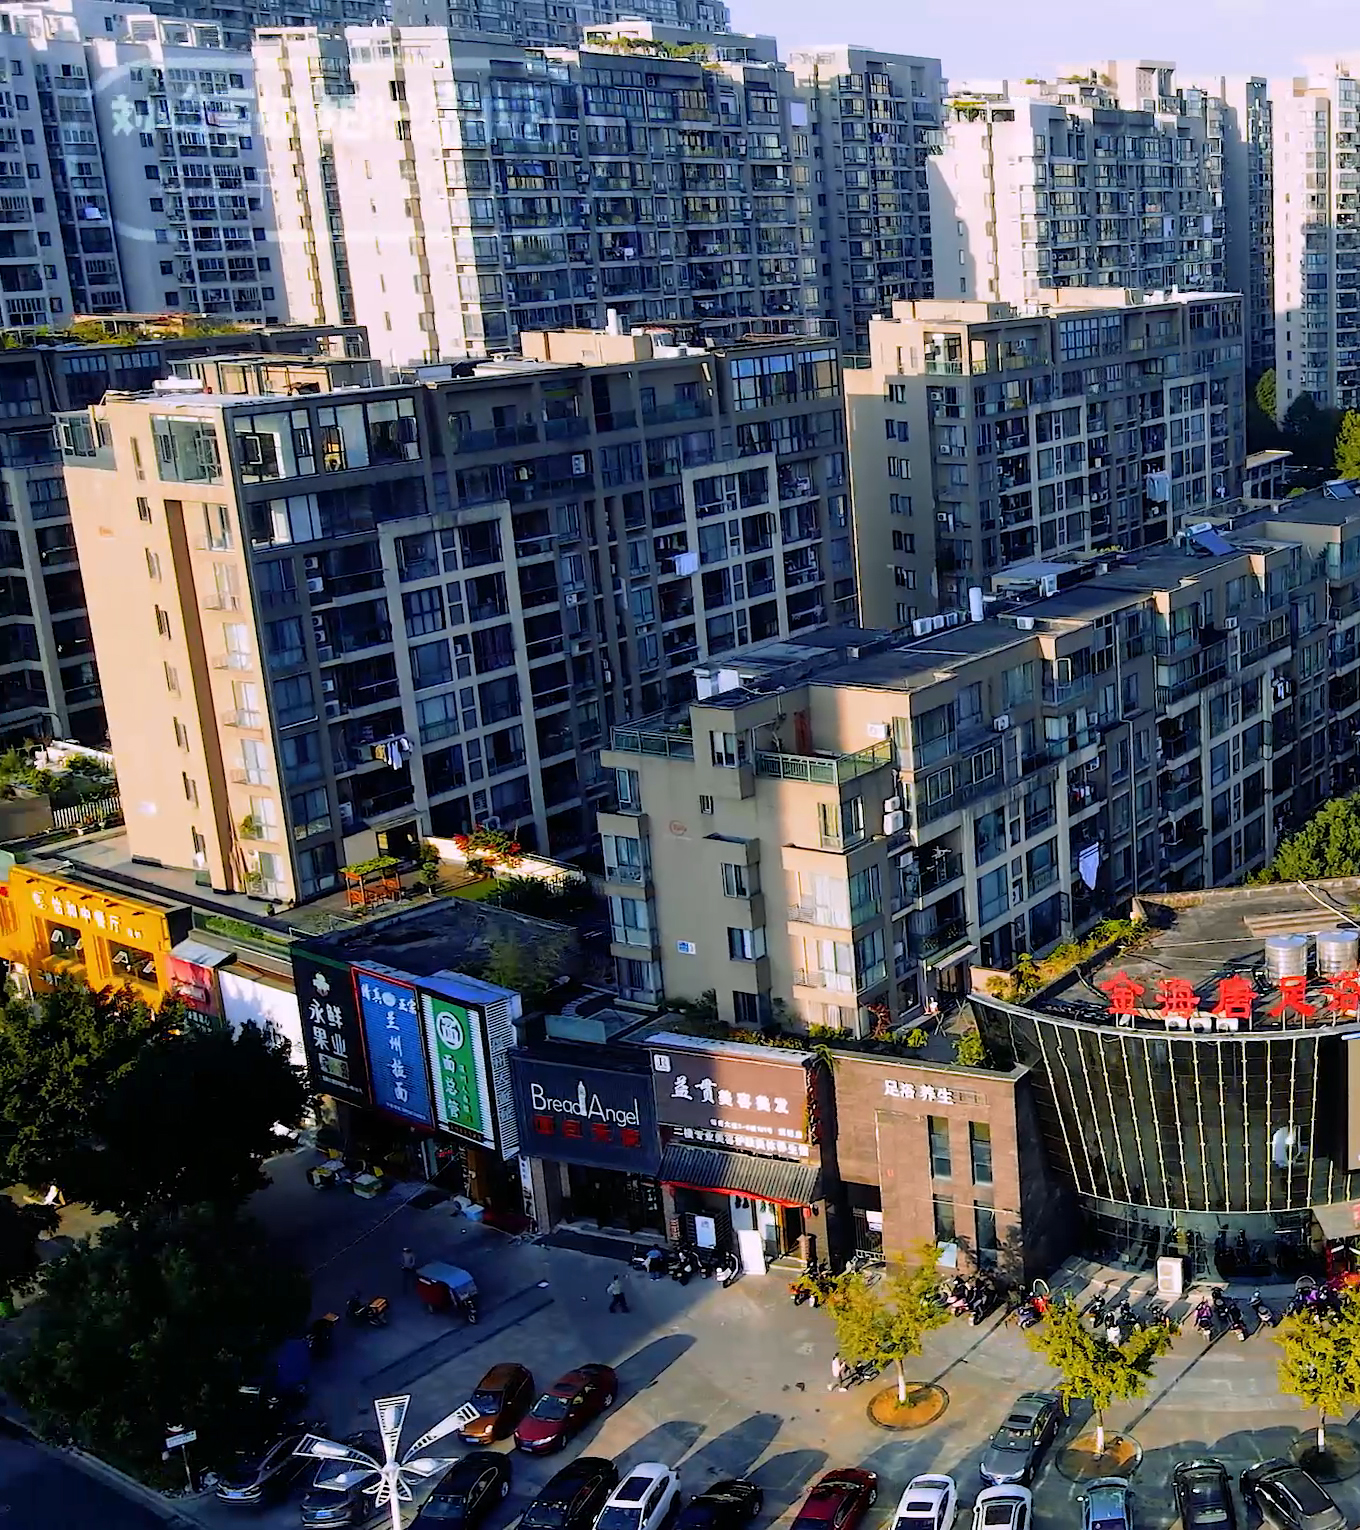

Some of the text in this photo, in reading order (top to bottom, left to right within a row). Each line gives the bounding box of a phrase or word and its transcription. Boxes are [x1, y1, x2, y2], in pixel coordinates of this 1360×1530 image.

[385, 1010, 410, 1104] 兰州拉面
[531, 1081, 640, 1127] Bread Angel
[884, 1079, 954, 1105] 足浴 养生
